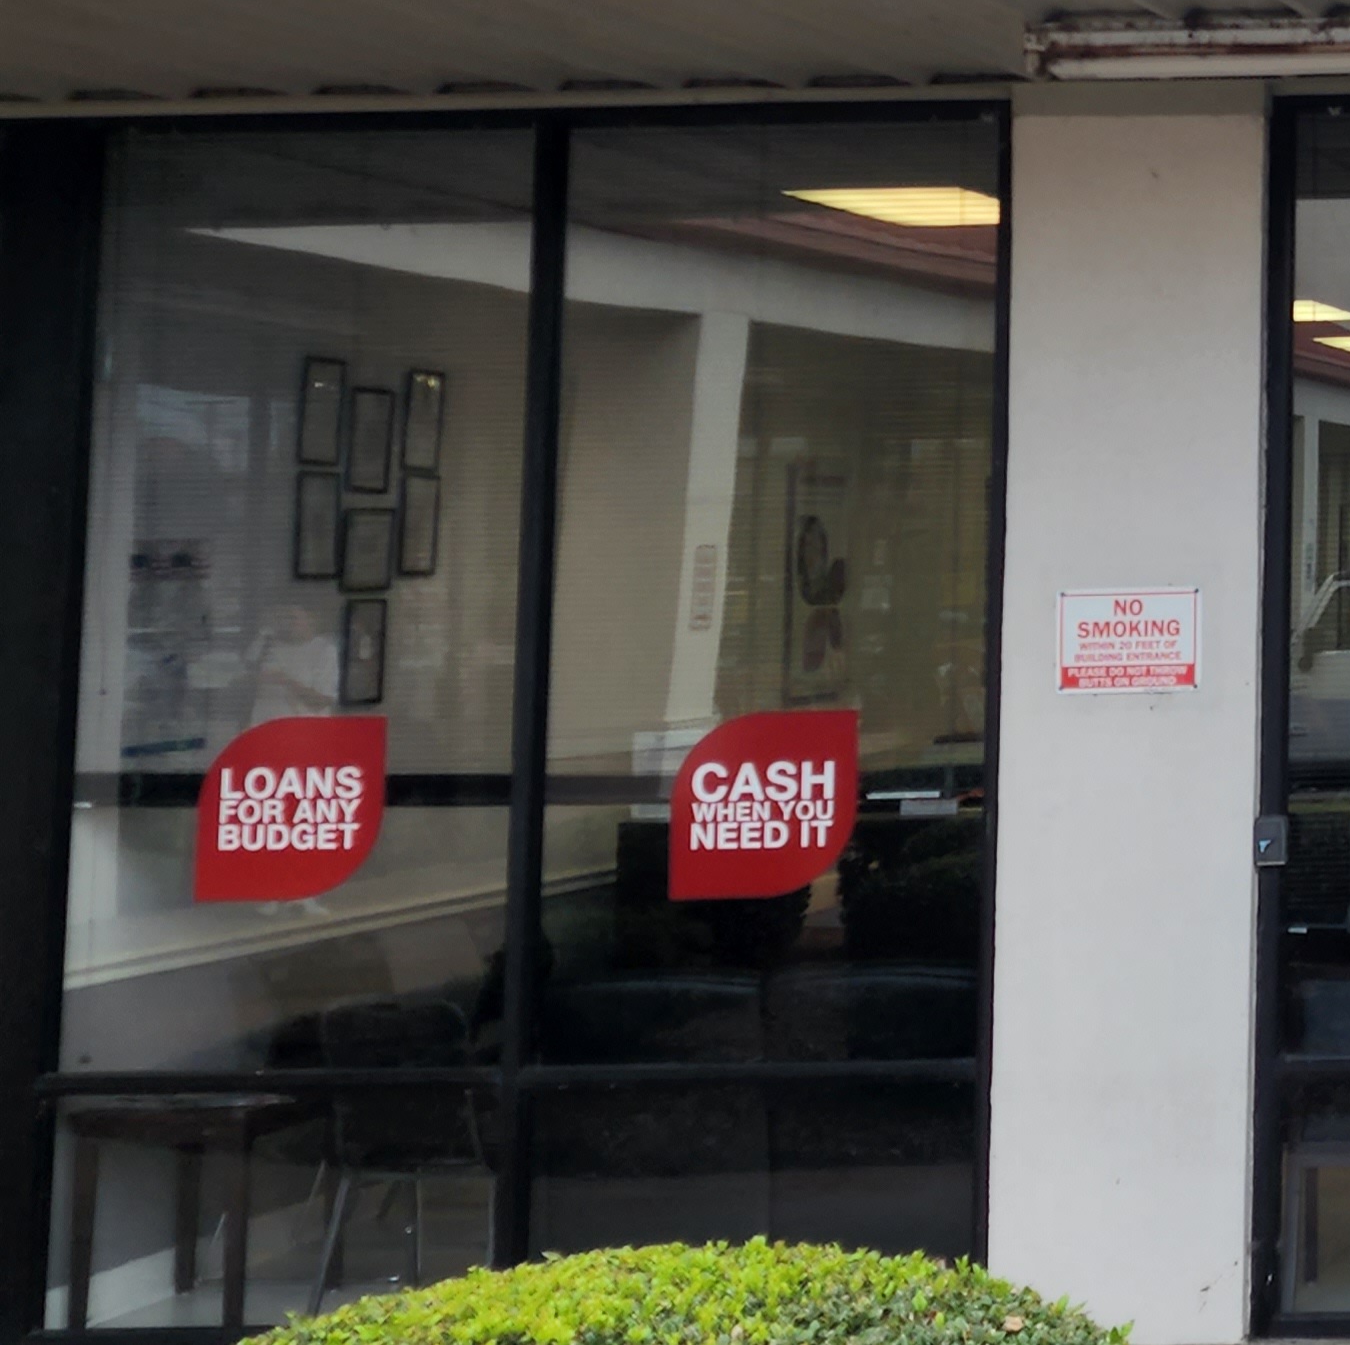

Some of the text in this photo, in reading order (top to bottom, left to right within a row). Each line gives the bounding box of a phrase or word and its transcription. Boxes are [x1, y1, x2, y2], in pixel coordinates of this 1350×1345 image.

[1113, 599, 1144, 616] NO
[1077, 619, 1180, 639] SMOKING
[1074, 651, 1182, 663] BUILDING ENTRANCE
[1079, 640, 1177, 651] WITHIN 20 FEET OF
[220, 765, 363, 800] LOANS
[691, 760, 836, 803] CASH
[219, 798, 363, 824] FOR ANY
[692, 800, 835, 823] WHEN YOU
[217, 823, 361, 852] BUDGET
[690, 820, 833, 850] NEED IT
